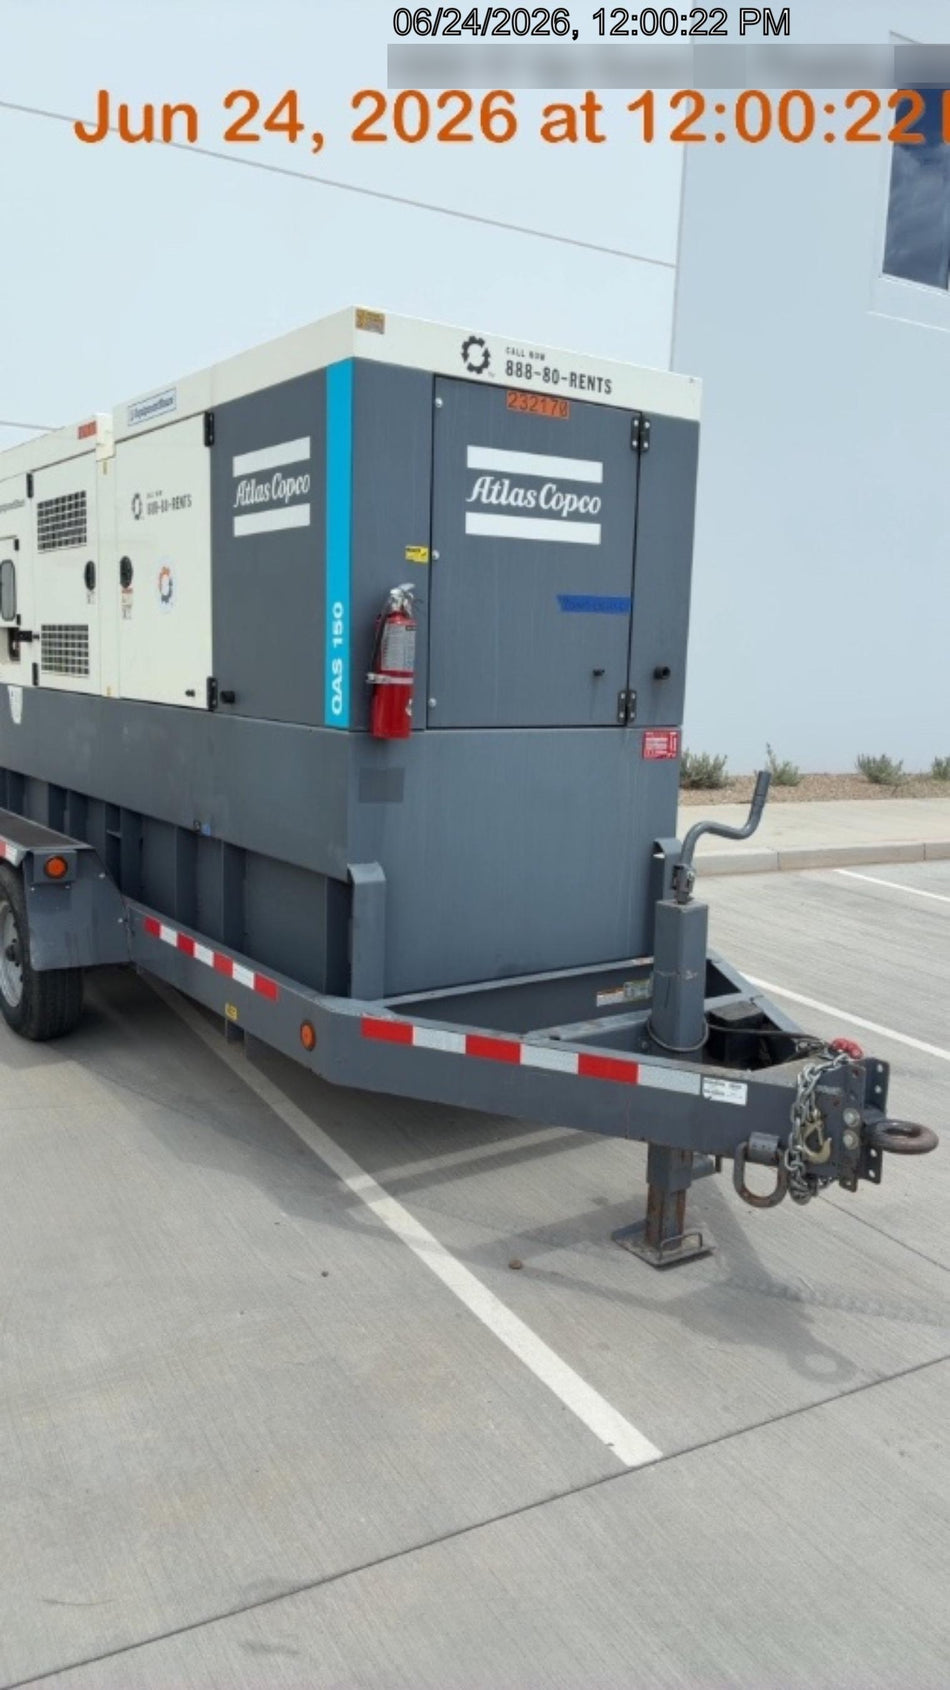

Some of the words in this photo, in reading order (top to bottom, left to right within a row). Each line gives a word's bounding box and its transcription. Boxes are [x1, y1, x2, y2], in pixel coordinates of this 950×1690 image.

[506, 346, 525, 358] CALL
[529, 351, 545, 361] NOW
[505, 359, 613, 395] 888-80-RENTS
[233, 478, 271, 508] Atlas
[271, 472, 311, 504] Copco
[465, 476, 537, 508] Atlas
[538, 482, 602, 517] Copco
[332, 601, 344, 648] 150
[331, 658, 343, 715] QAS
